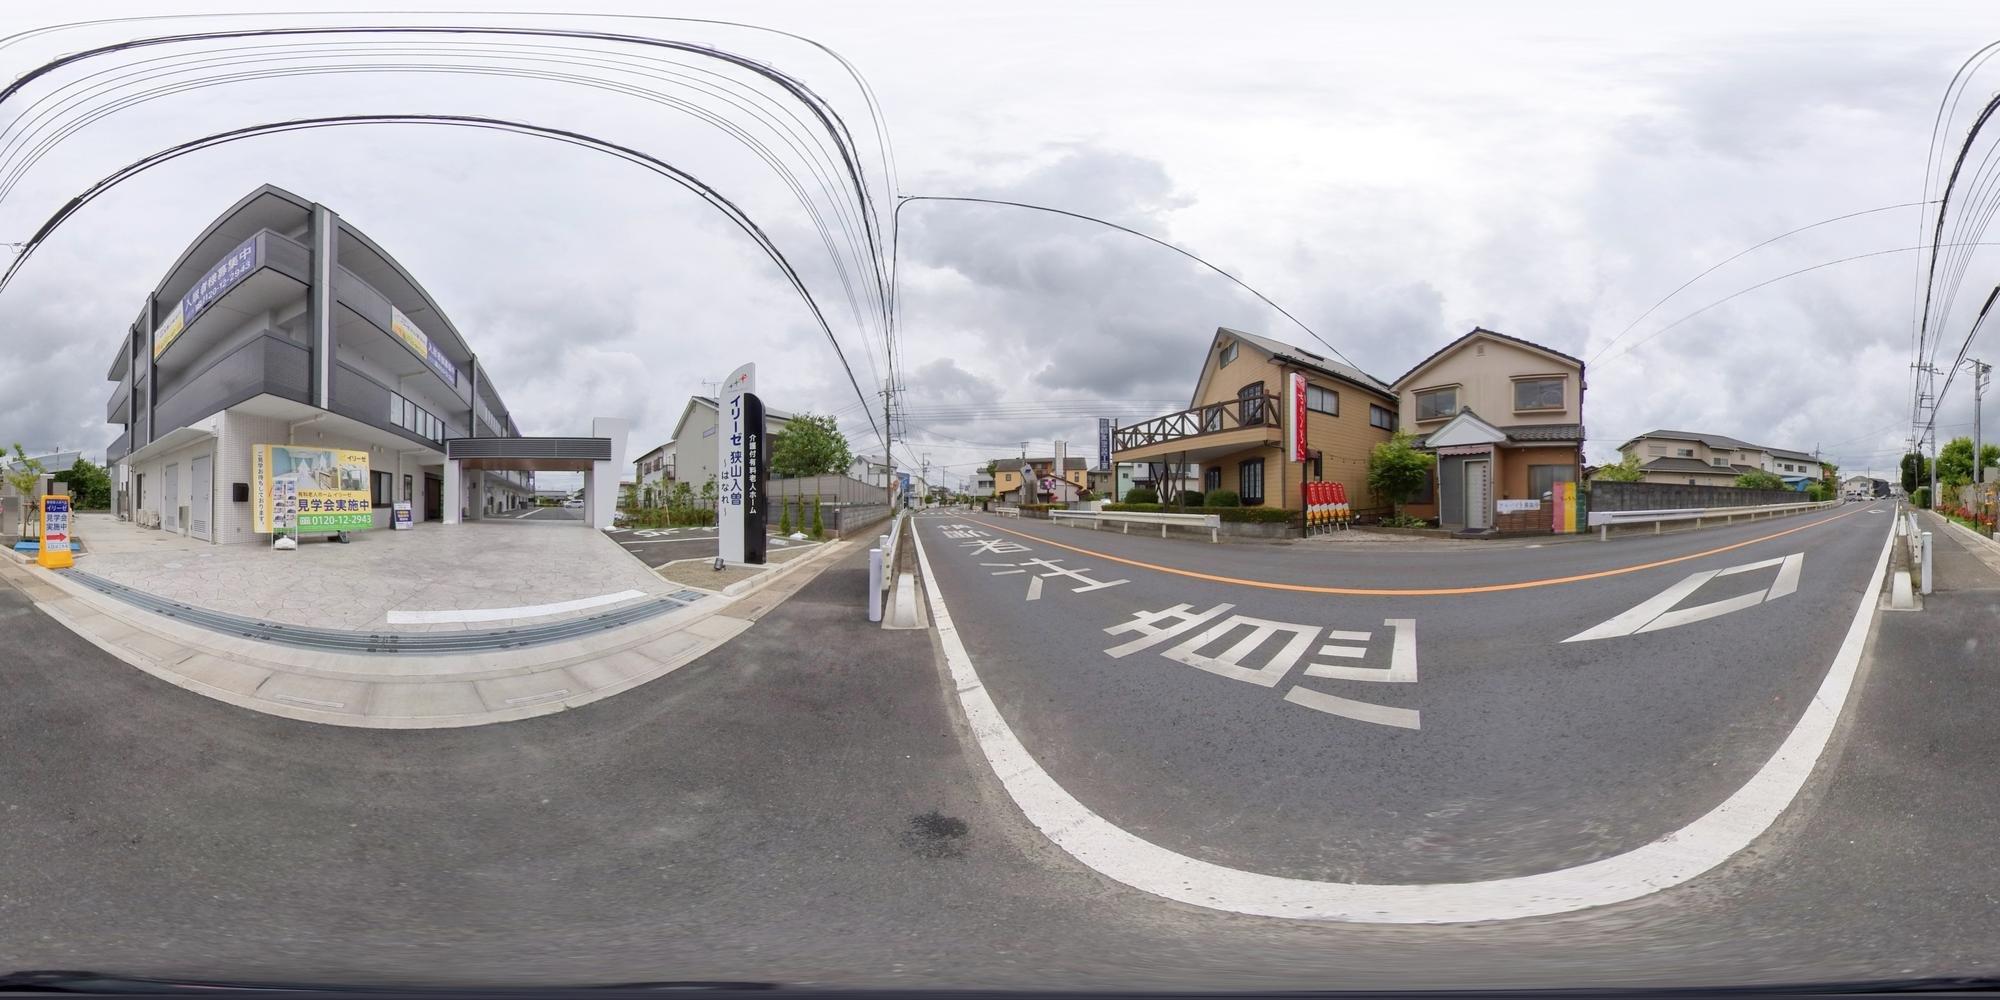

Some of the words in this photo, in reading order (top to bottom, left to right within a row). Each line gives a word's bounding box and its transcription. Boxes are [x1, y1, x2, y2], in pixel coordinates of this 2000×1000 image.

[730, 395, 742, 446] イリーゼ
[730, 451, 742, 506] 狭山入曽
[298, 499, 369, 512] 見学会実施中
[46, 514, 67, 522] 見学会
[312, 515, 372, 525] 0120-12-2943
[46, 523, 67, 531] 実施中
